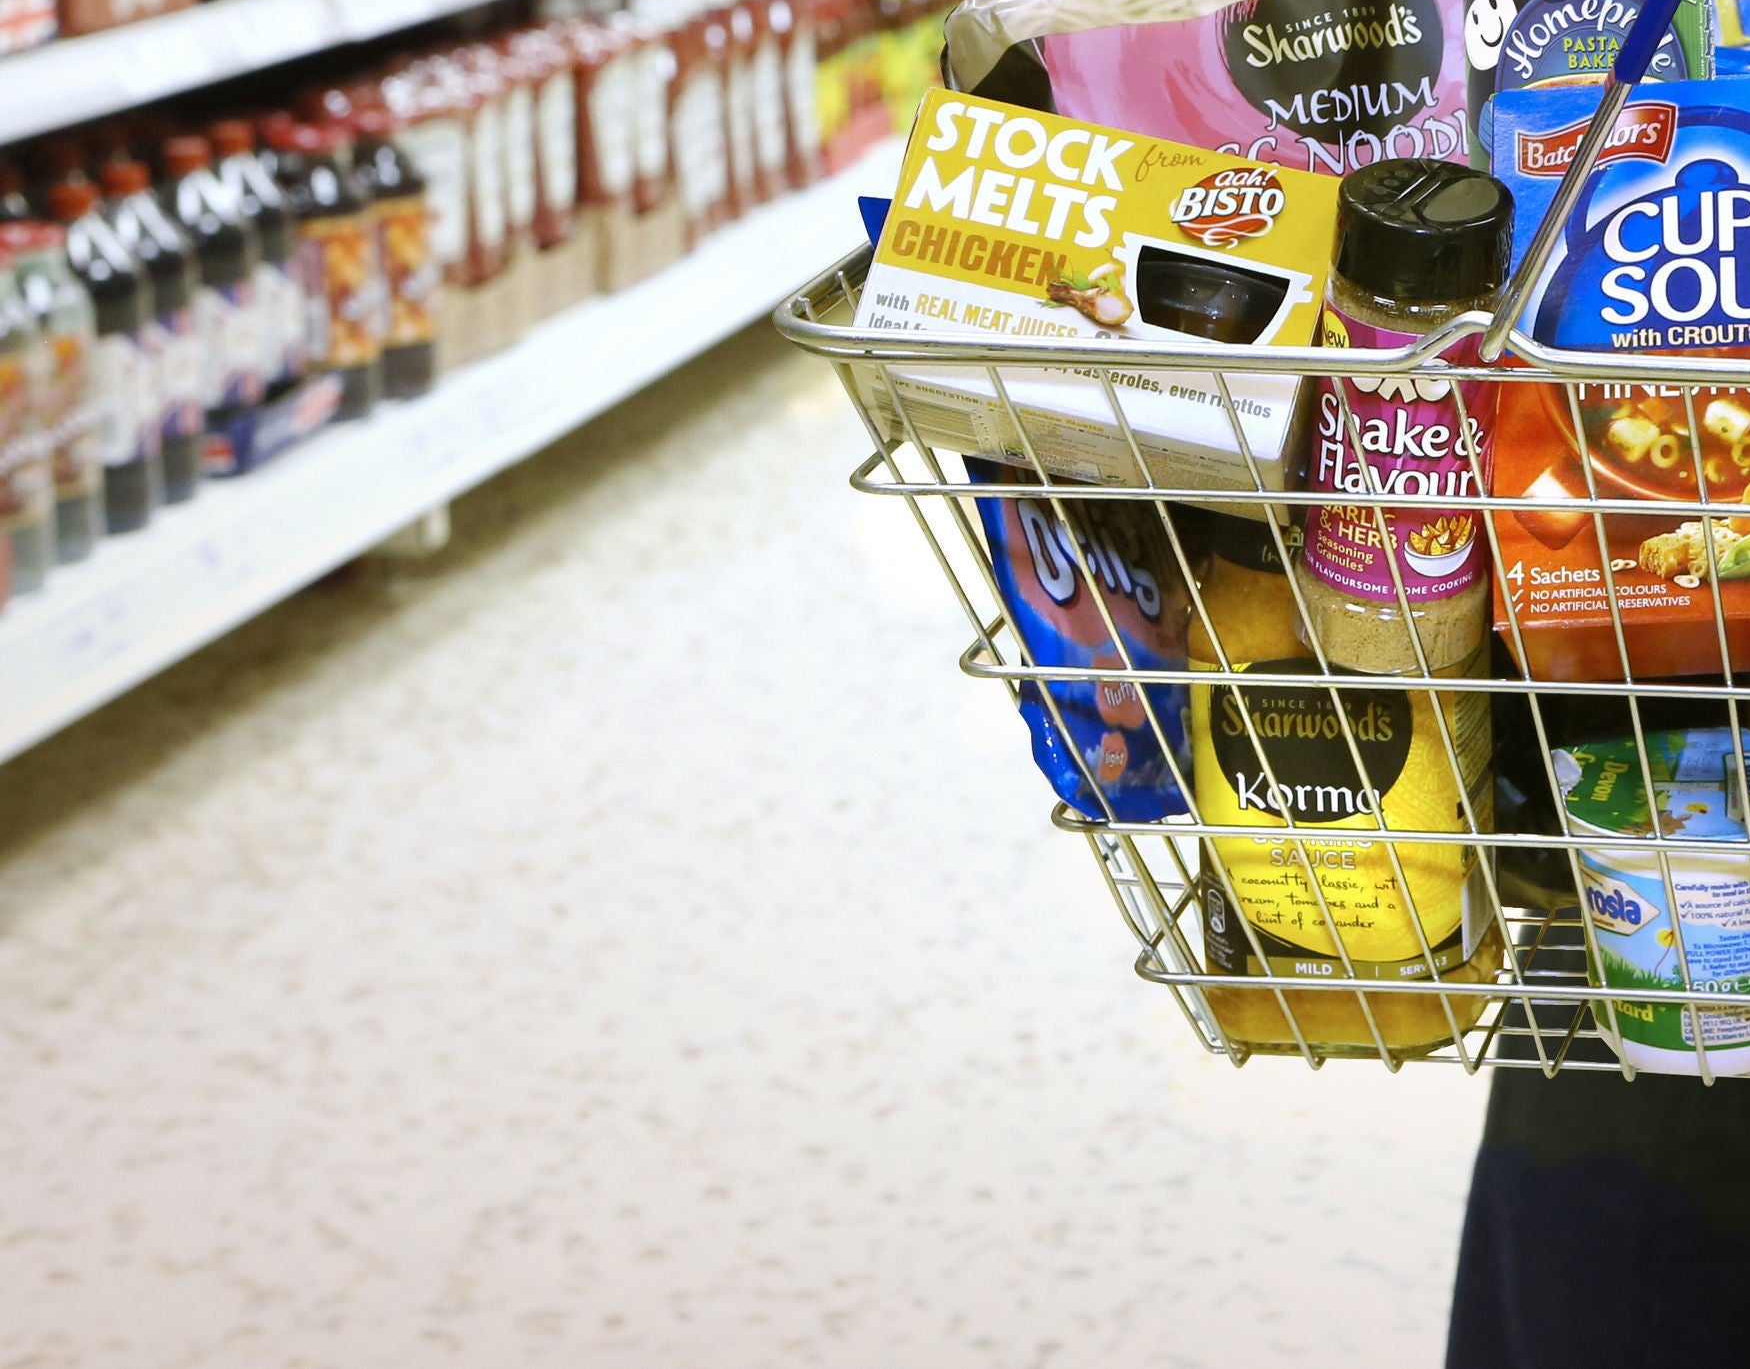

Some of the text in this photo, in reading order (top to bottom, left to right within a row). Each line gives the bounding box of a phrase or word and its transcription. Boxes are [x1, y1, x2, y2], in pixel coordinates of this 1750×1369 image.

[1285, 5, 1377, 33] SINCE 1889
[1242, 2, 1423, 68] Sharwood's
[1563, 35, 1621, 53] PASTA
[1567, 53, 1614, 69] BAKE
[1263, 76, 1440, 131] MEDIUM
[926, 101, 1135, 191] STOCK
[1134, 144, 1207, 182] from
[1215, 167, 1279, 187] aah!
[903, 156, 1118, 248] MELTS
[1171, 184, 1286, 223] BISTO
[891, 219, 1068, 287] CHICKEN
[875, 291, 910, 312] with
[915, 293, 960, 323] REAL
[962, 302, 1013, 335] MEAT
[1611, 328, 1662, 349] with
[1168, 383, 1207, 404] even
[1454, 417, 1485, 457] &
[1319, 440, 1475, 497] Flavour
[1319, 510, 1332, 533] &
[1316, 542, 1365, 573] Granules
[1317, 529, 1374, 565] Seasoning
[1315, 560, 1474, 594] FLAVOURSOME COOKING
[1506, 561, 1600, 586] 4 Sachets
[1530, 589, 1550, 600] NO
[1551, 587, 1608, 599] ARTIFICIAL
[1530, 596, 1691, 613] NO ARTIFICIAL RESERVATIVES
[1261, 698, 1306, 709] SINCE
[1236, 771, 1385, 815] Korma
[1590, 760, 1631, 803] Devon
[1271, 849, 1357, 870] SAUCE
[1241, 873, 1308, 893] coconutty
[1355, 898, 1396, 911] and a
[1256, 912, 1303, 930] hint of
[1295, 962, 1333, 976] MILD
